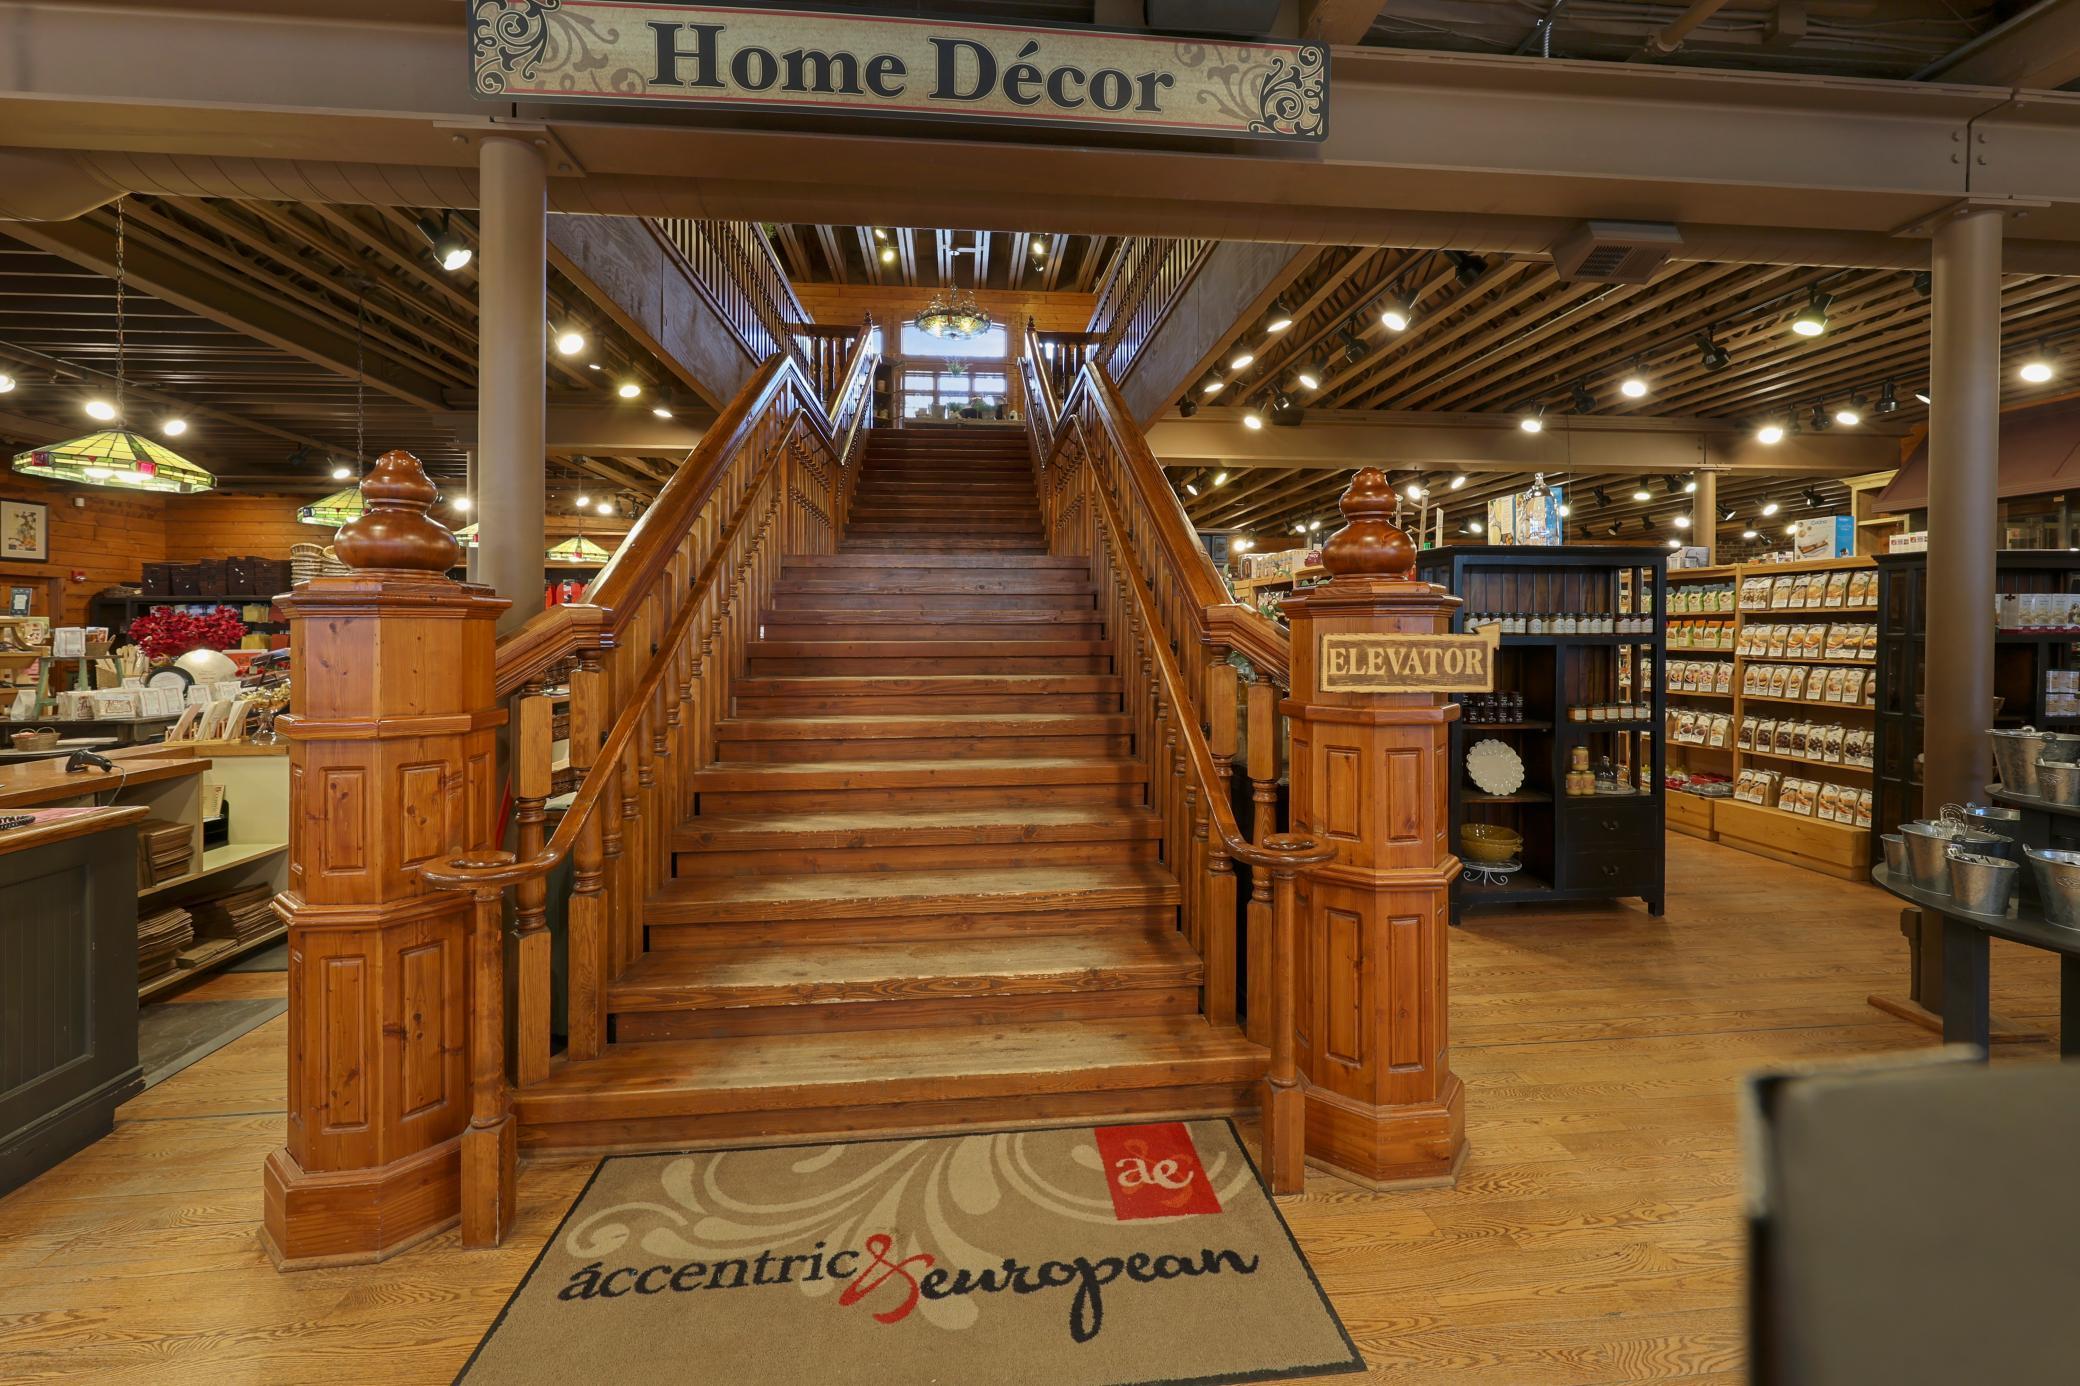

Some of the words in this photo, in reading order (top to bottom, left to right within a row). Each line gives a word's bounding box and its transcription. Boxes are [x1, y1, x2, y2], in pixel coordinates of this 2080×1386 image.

[646, 20, 907, 98] Home
[927, 36, 1176, 113] Décor
[1329, 647, 1484, 675] ELEVATOR
[920, 1248, 1259, 1343] european
